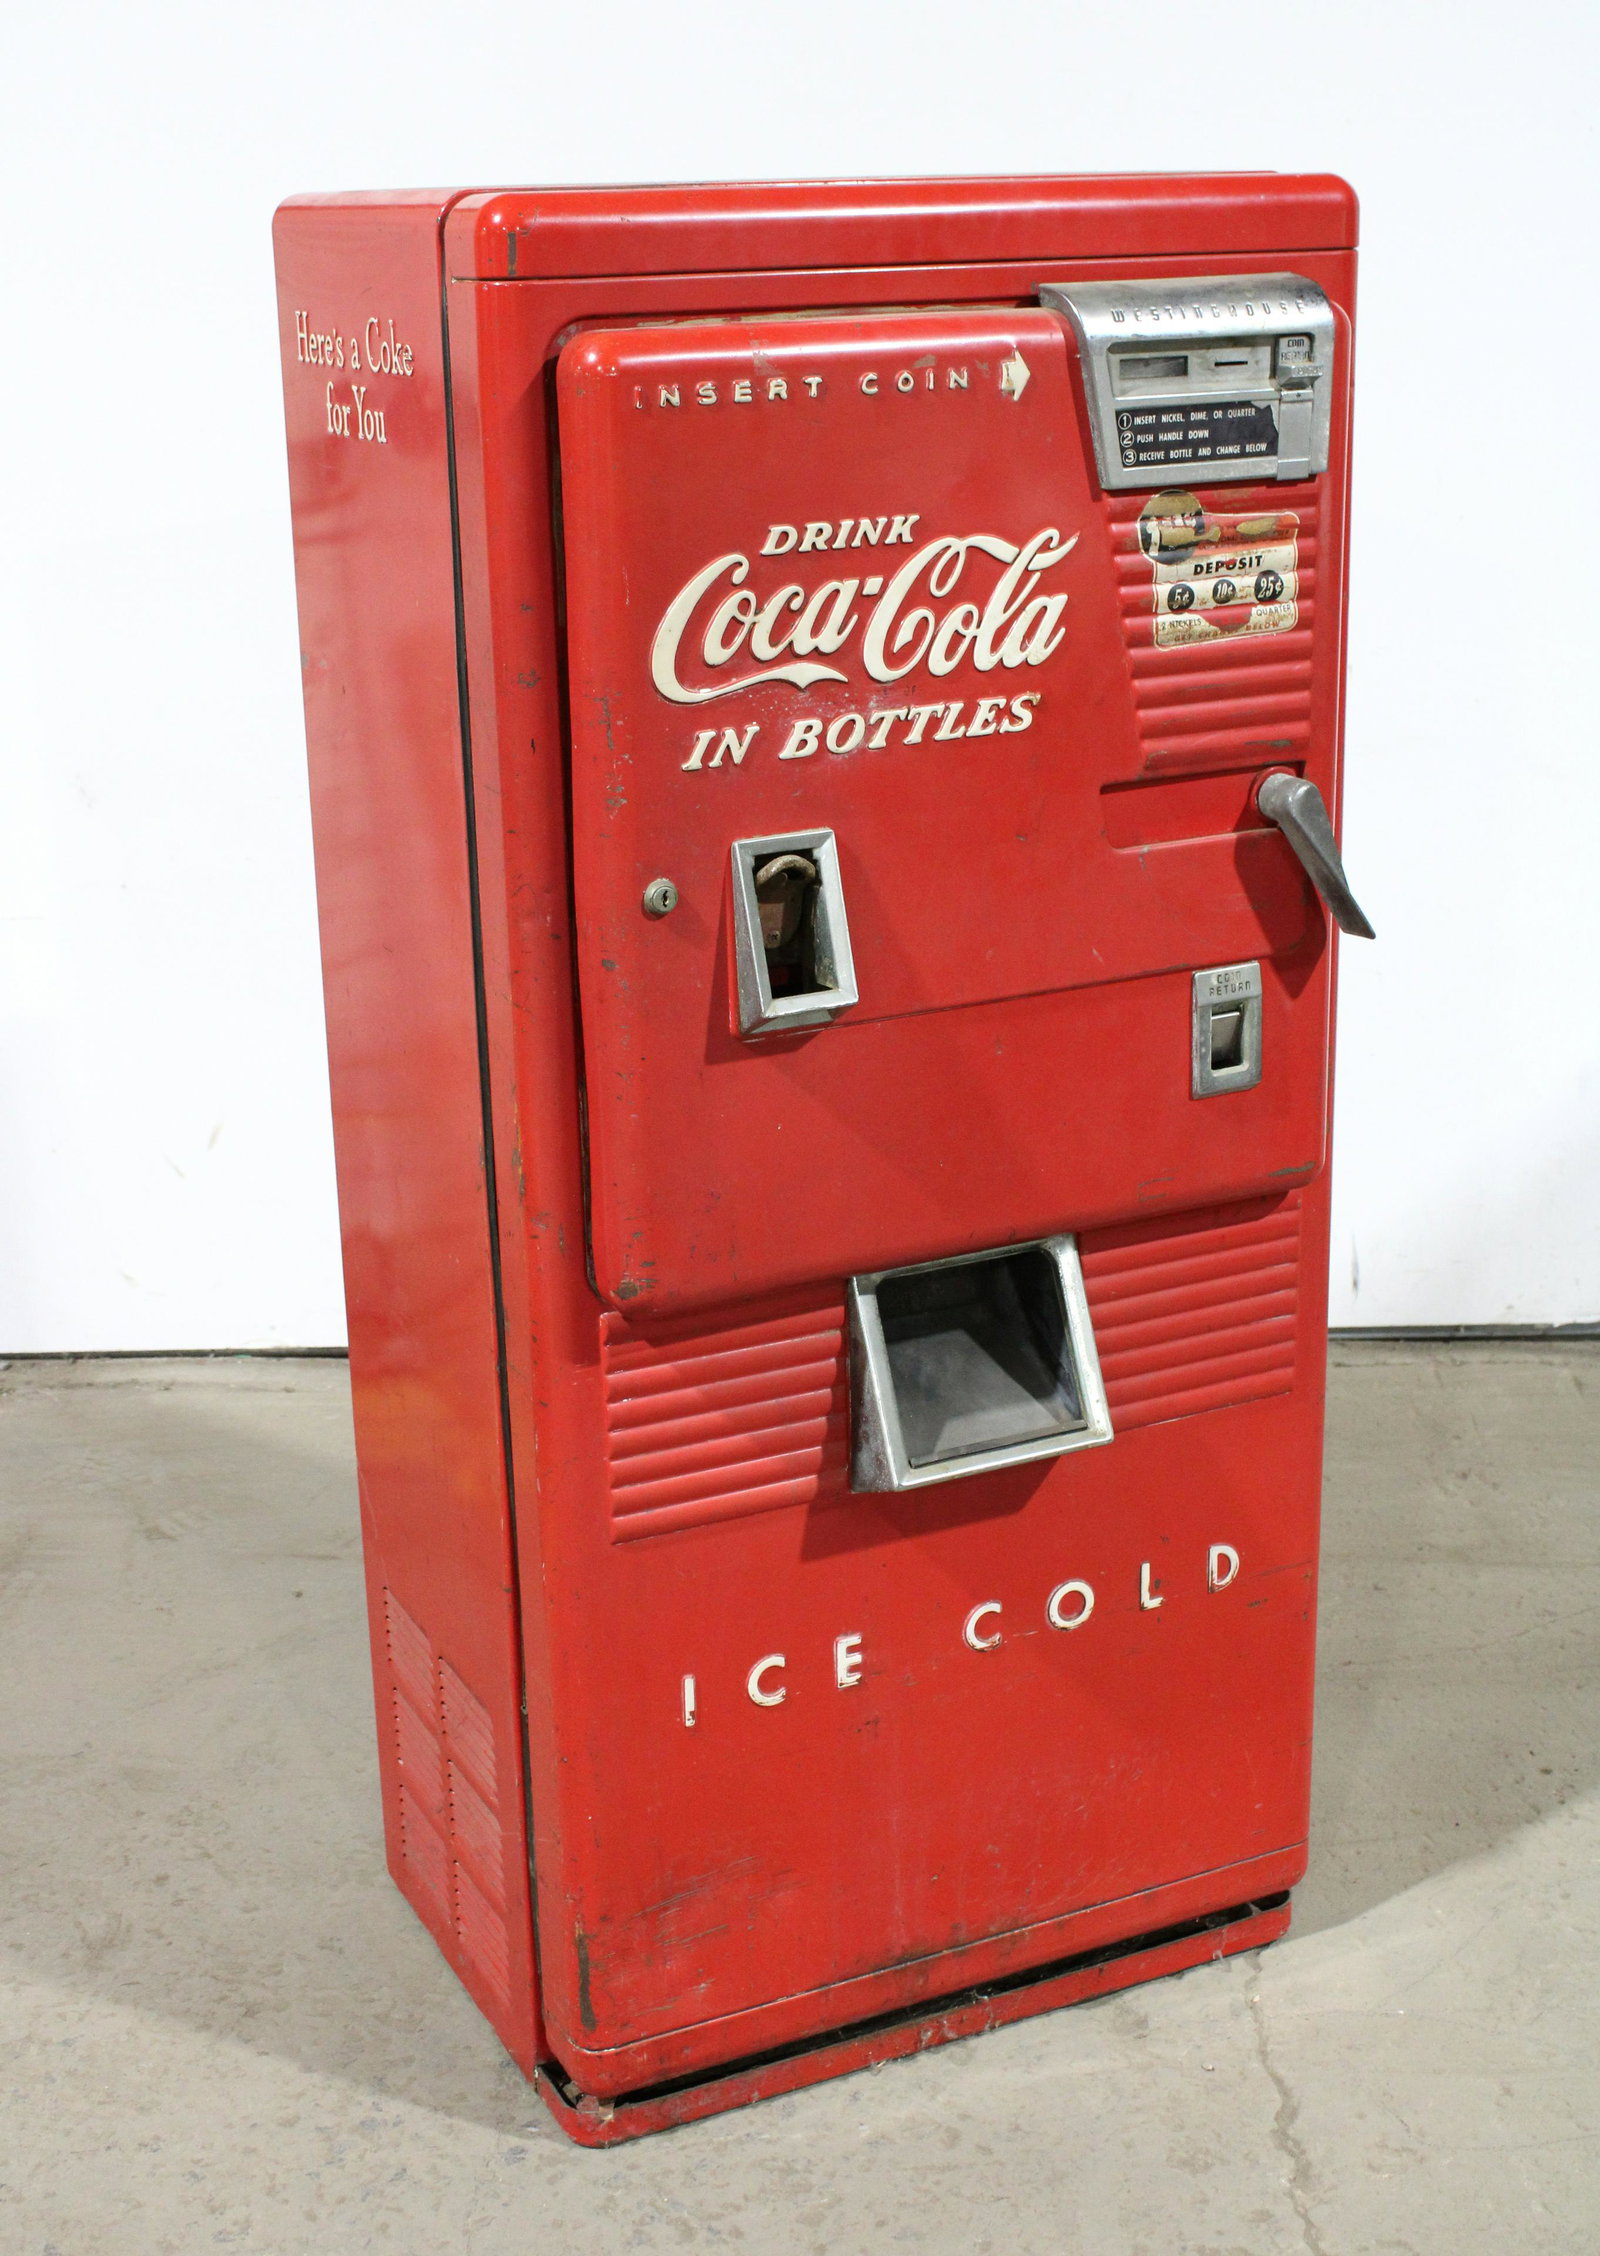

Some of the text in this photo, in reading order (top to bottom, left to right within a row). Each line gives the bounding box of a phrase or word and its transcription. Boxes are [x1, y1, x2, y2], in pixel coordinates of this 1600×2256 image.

[1110, 300, 1306, 323] WESTINGHOUSE
[295, 310, 414, 376] Here's a Coke
[633, 366, 968, 408] INSERT COIN
[326, 381, 387, 443] for You
[1134, 414, 1156, 426] INSERT
[1213, 409, 1223, 419] OR
[1227, 407, 1256, 418] QUARTER
[1136, 433, 1154, 444] PUSH
[1158, 430, 1183, 442] HANDLE
[1188, 429, 1209, 440] DOWN
[1139, 450, 1165, 462] RECEIVE
[1169, 448, 1193, 459] BOTTLE
[1198, 446, 1212, 457] AND
[1216, 444, 1241, 456] CHANGE
[1245, 442, 1267, 454] BELOW
[760, 514, 921, 558] DRINK
[1193, 555, 1263, 576] DEPOSIT
[1257, 576, 1283, 600] 25¢
[651, 528, 1080, 704] Coca-Cola
[1256, 604, 1291, 617] QUARTER
[681, 692, 1042, 771] IN BOTTLES
[1209, 981, 1251, 997] RETURN
[1216, 971, 1241, 984] COIN
[681, 1543, 1240, 1728] ICE COLD
